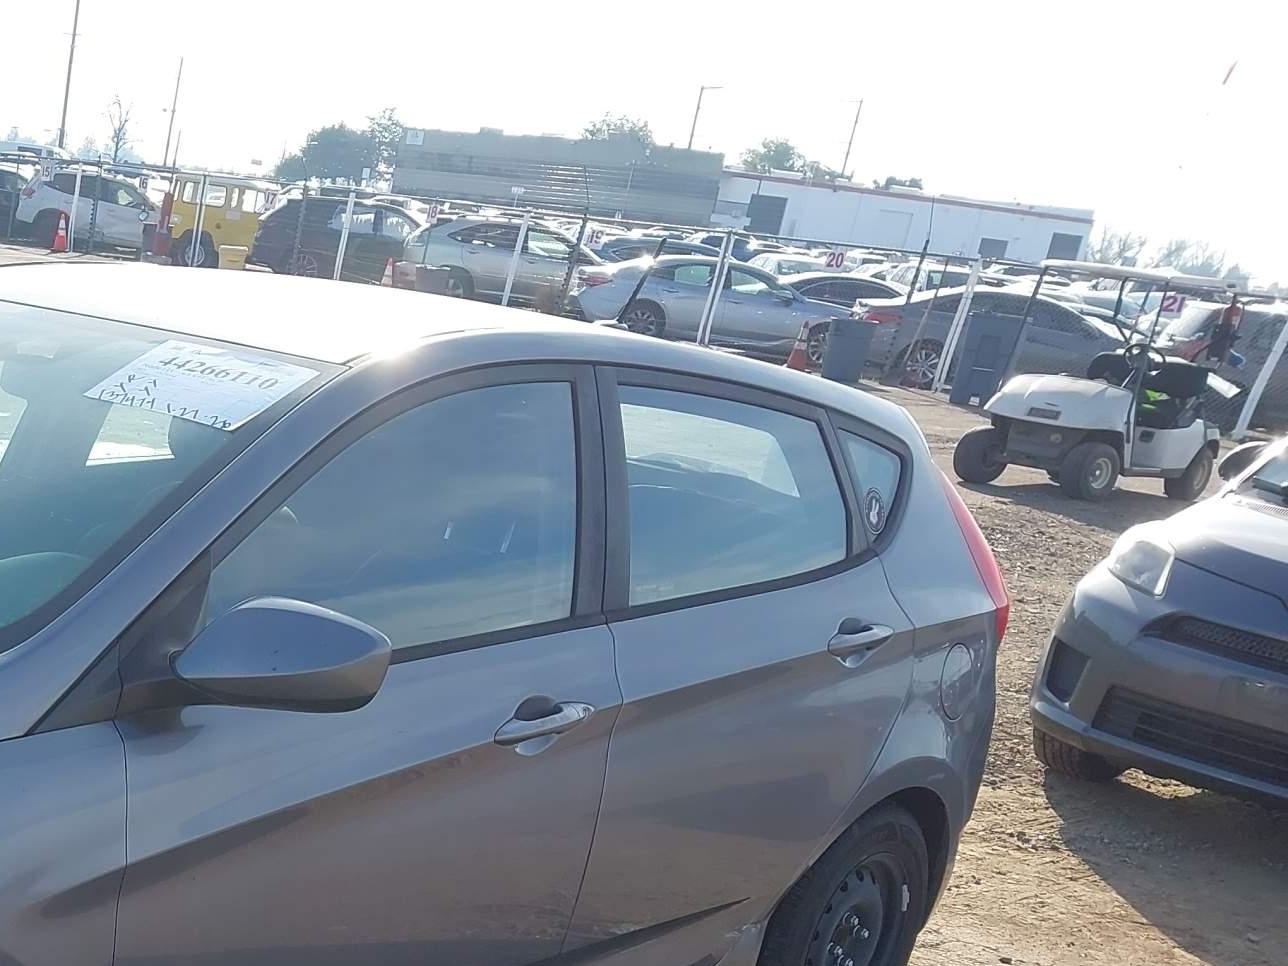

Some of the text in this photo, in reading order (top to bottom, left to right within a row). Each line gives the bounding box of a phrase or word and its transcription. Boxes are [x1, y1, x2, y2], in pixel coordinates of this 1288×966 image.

[139, 176, 148, 190] 16
[825, 252, 844, 268] 20
[1162, 295, 1186, 312] 21
[159, 356, 279, 390] 44266110
